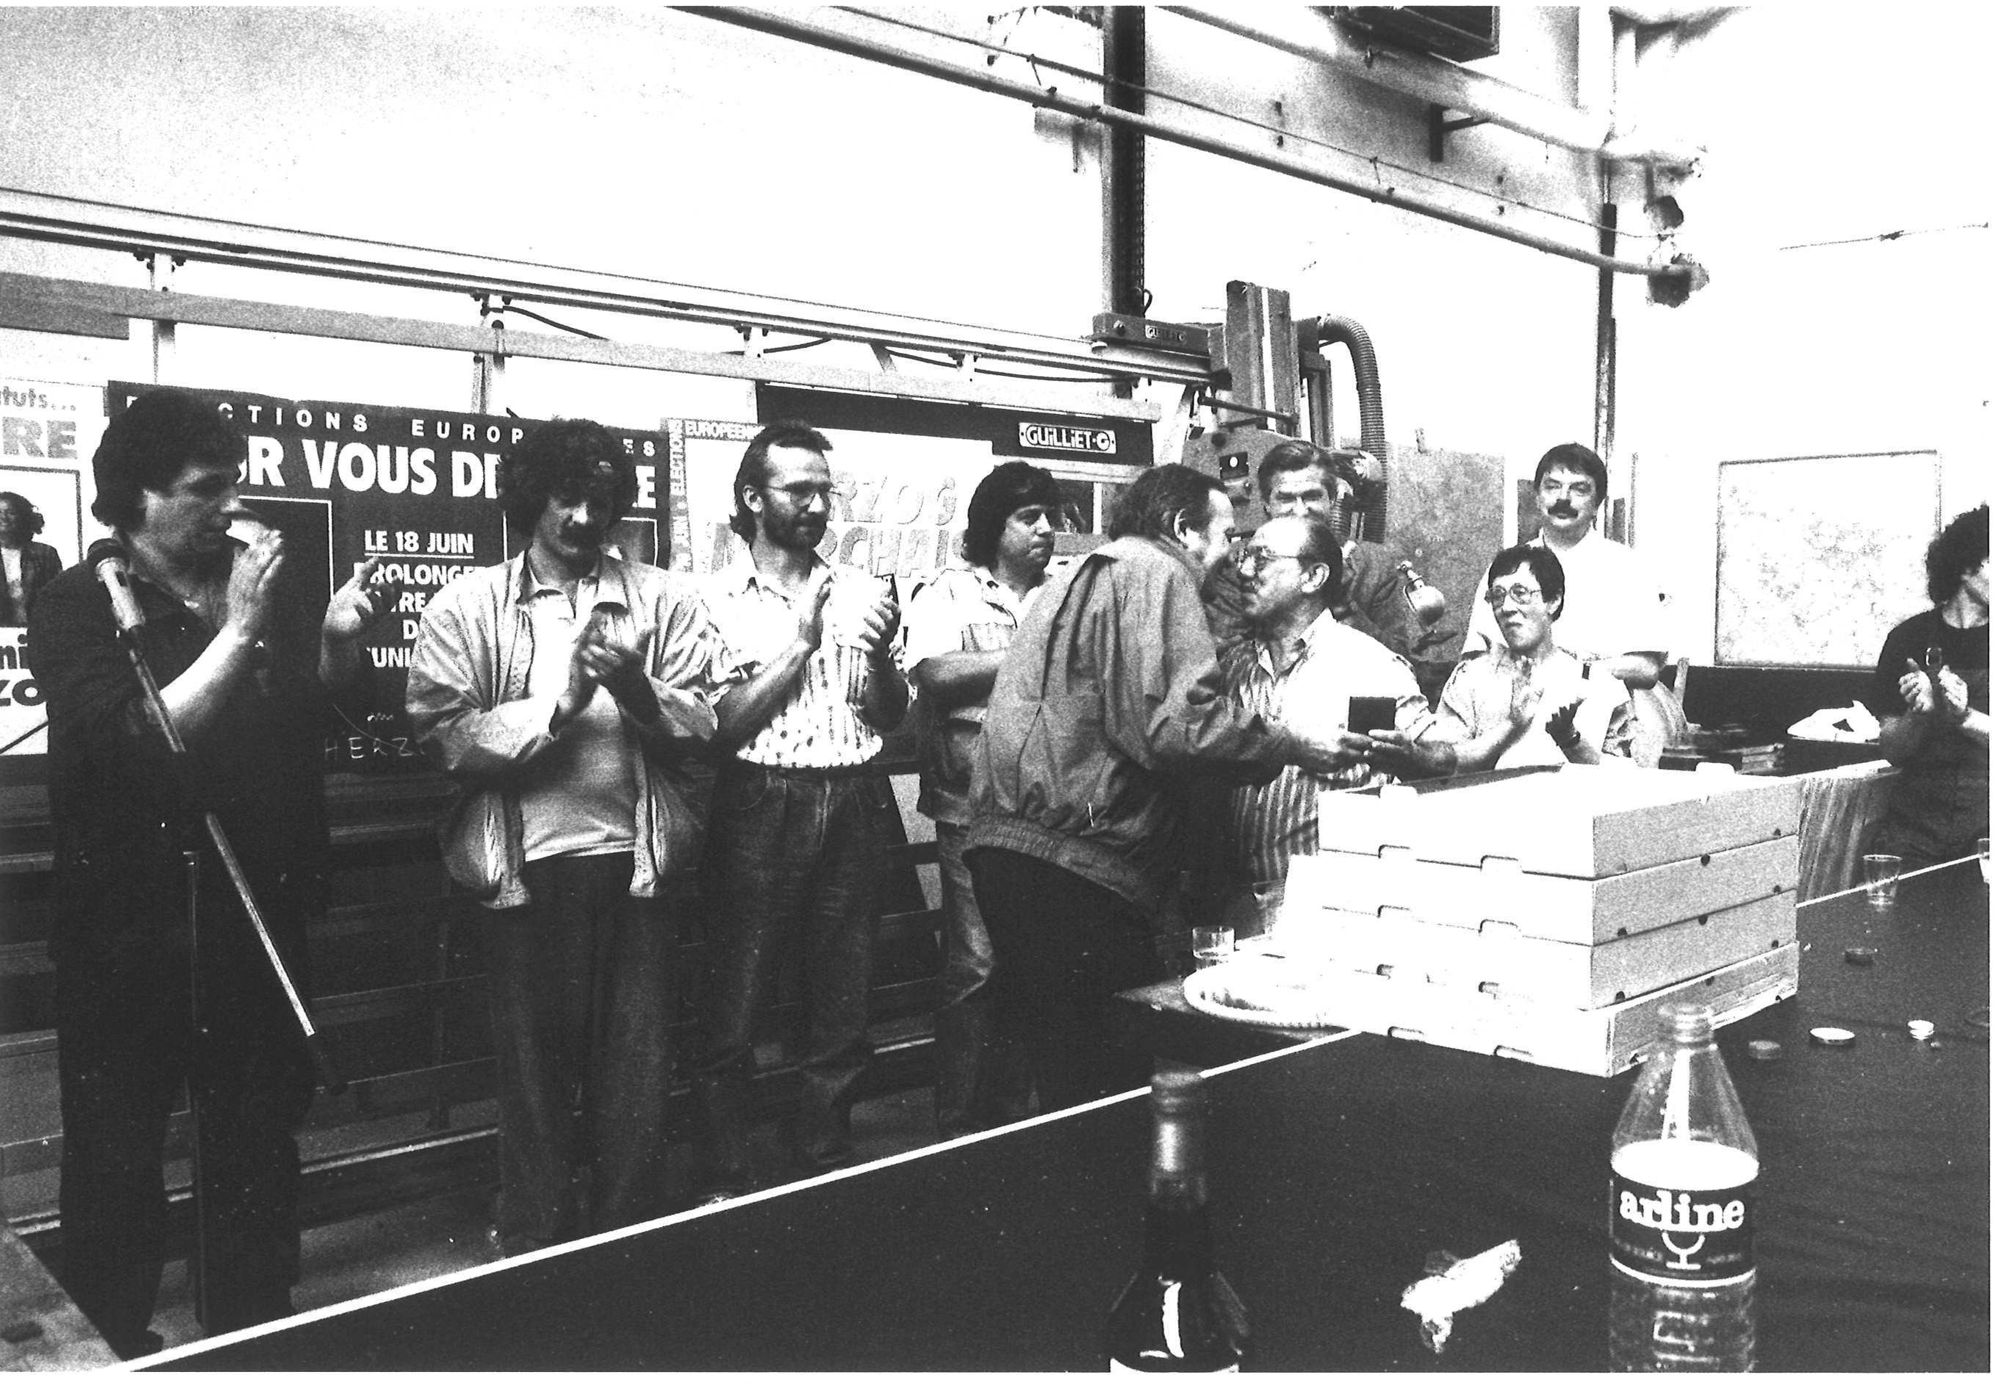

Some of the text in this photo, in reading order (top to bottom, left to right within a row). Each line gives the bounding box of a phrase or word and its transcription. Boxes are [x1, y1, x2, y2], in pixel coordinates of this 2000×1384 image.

[302, 438, 437, 496] VOUS
[364, 529, 474, 554] LE 18 JUIN
